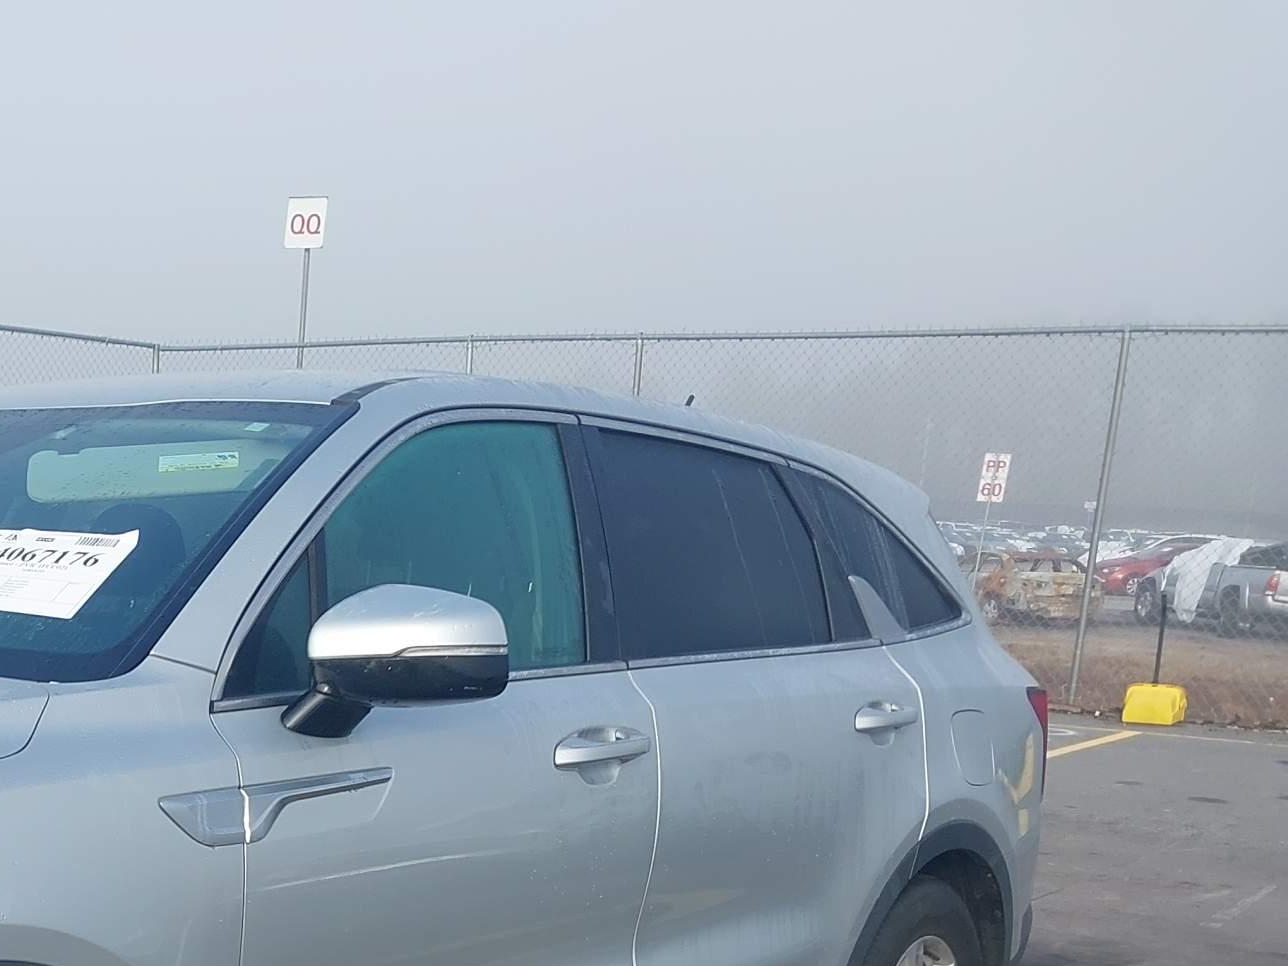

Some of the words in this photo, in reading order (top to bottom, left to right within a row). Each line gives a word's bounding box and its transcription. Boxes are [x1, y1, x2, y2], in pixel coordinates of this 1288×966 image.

[290, 213, 321, 235] QQ
[986, 460, 1007, 473] PP
[981, 482, 1002, 496] 60
